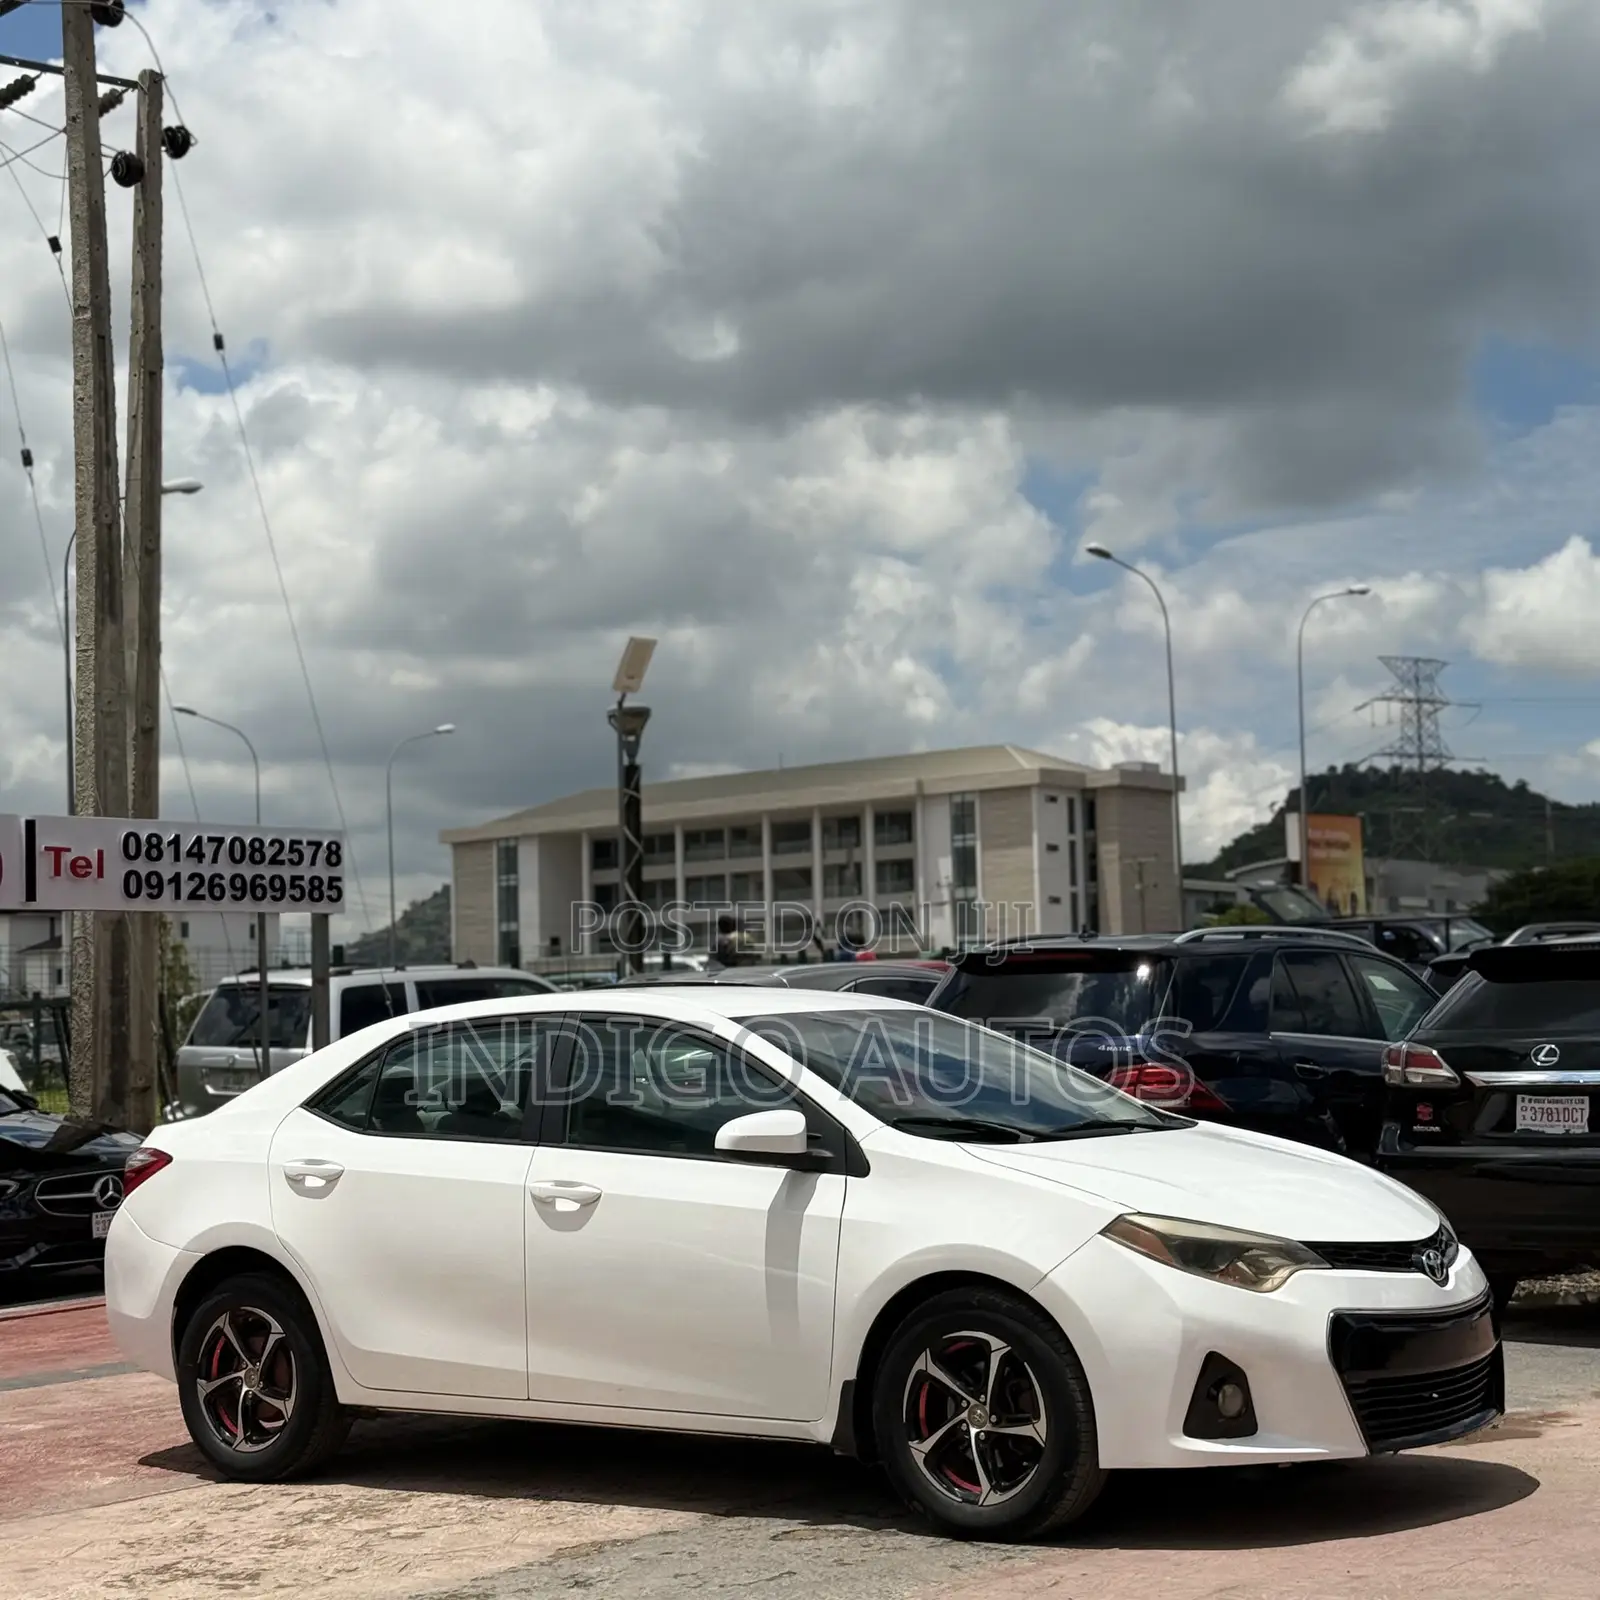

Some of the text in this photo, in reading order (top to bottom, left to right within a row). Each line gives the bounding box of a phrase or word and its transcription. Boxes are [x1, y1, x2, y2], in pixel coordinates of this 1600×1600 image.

[43, 846, 105, 879] Tel
[122, 831, 342, 868] 08147082578
[122, 869, 344, 903] 09126969585
[1529, 1106, 1586, 1124] 3781DCT
